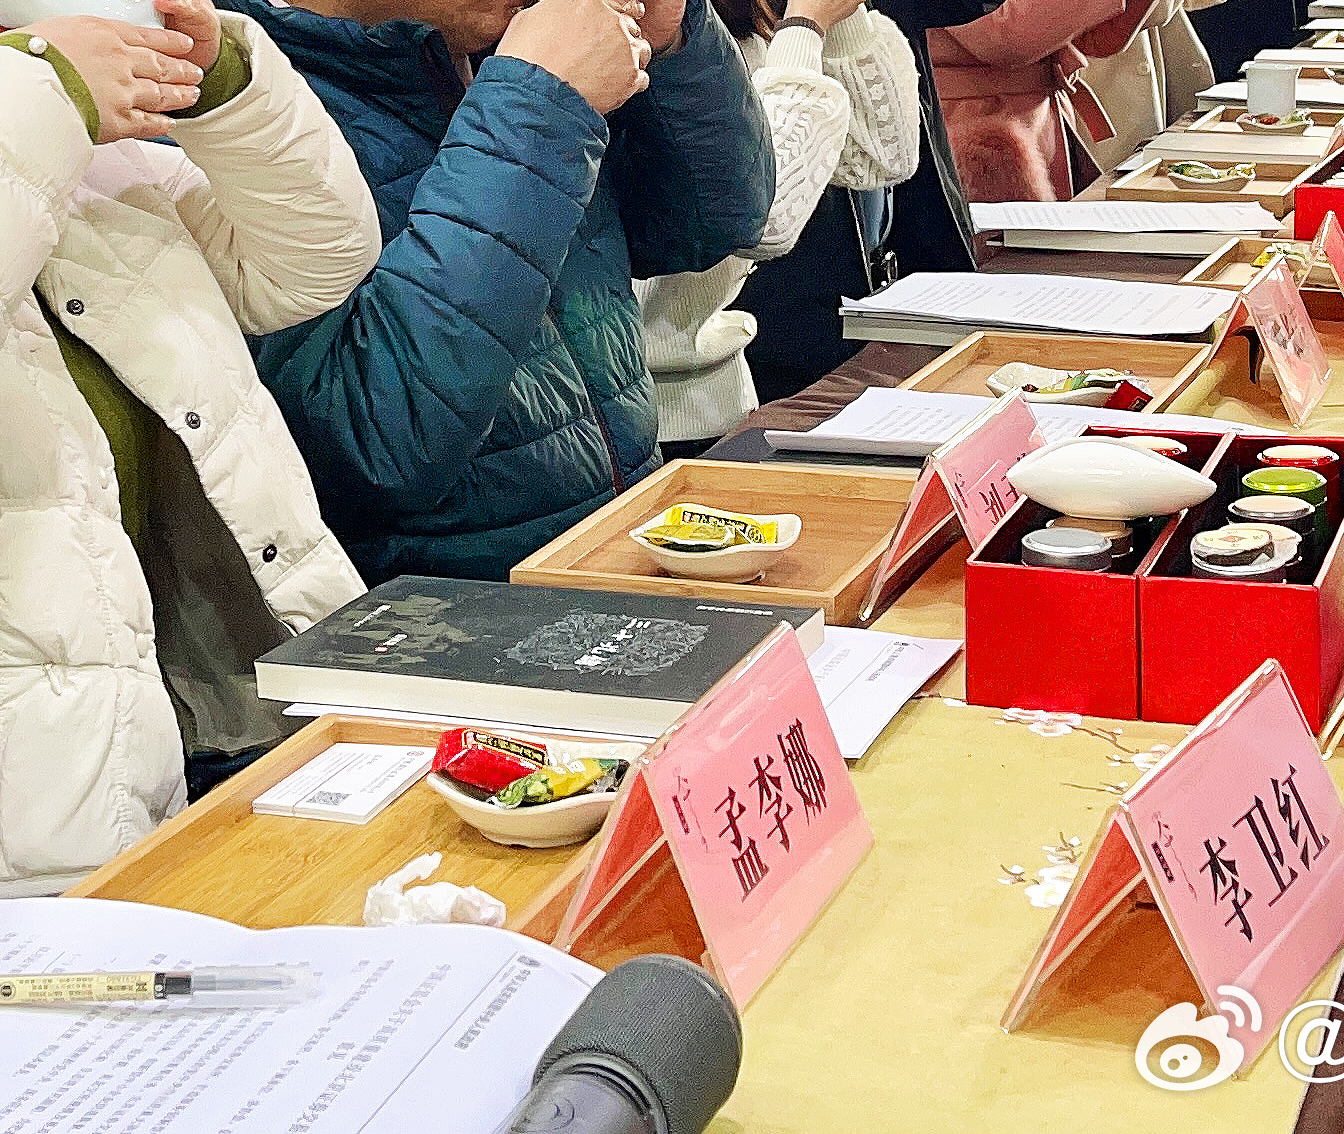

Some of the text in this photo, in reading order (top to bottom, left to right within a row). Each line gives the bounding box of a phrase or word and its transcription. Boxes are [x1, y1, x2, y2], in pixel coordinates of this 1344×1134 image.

[714, 718, 827, 903] 孟李娜
[1199, 762, 1331, 943] 李卫红
